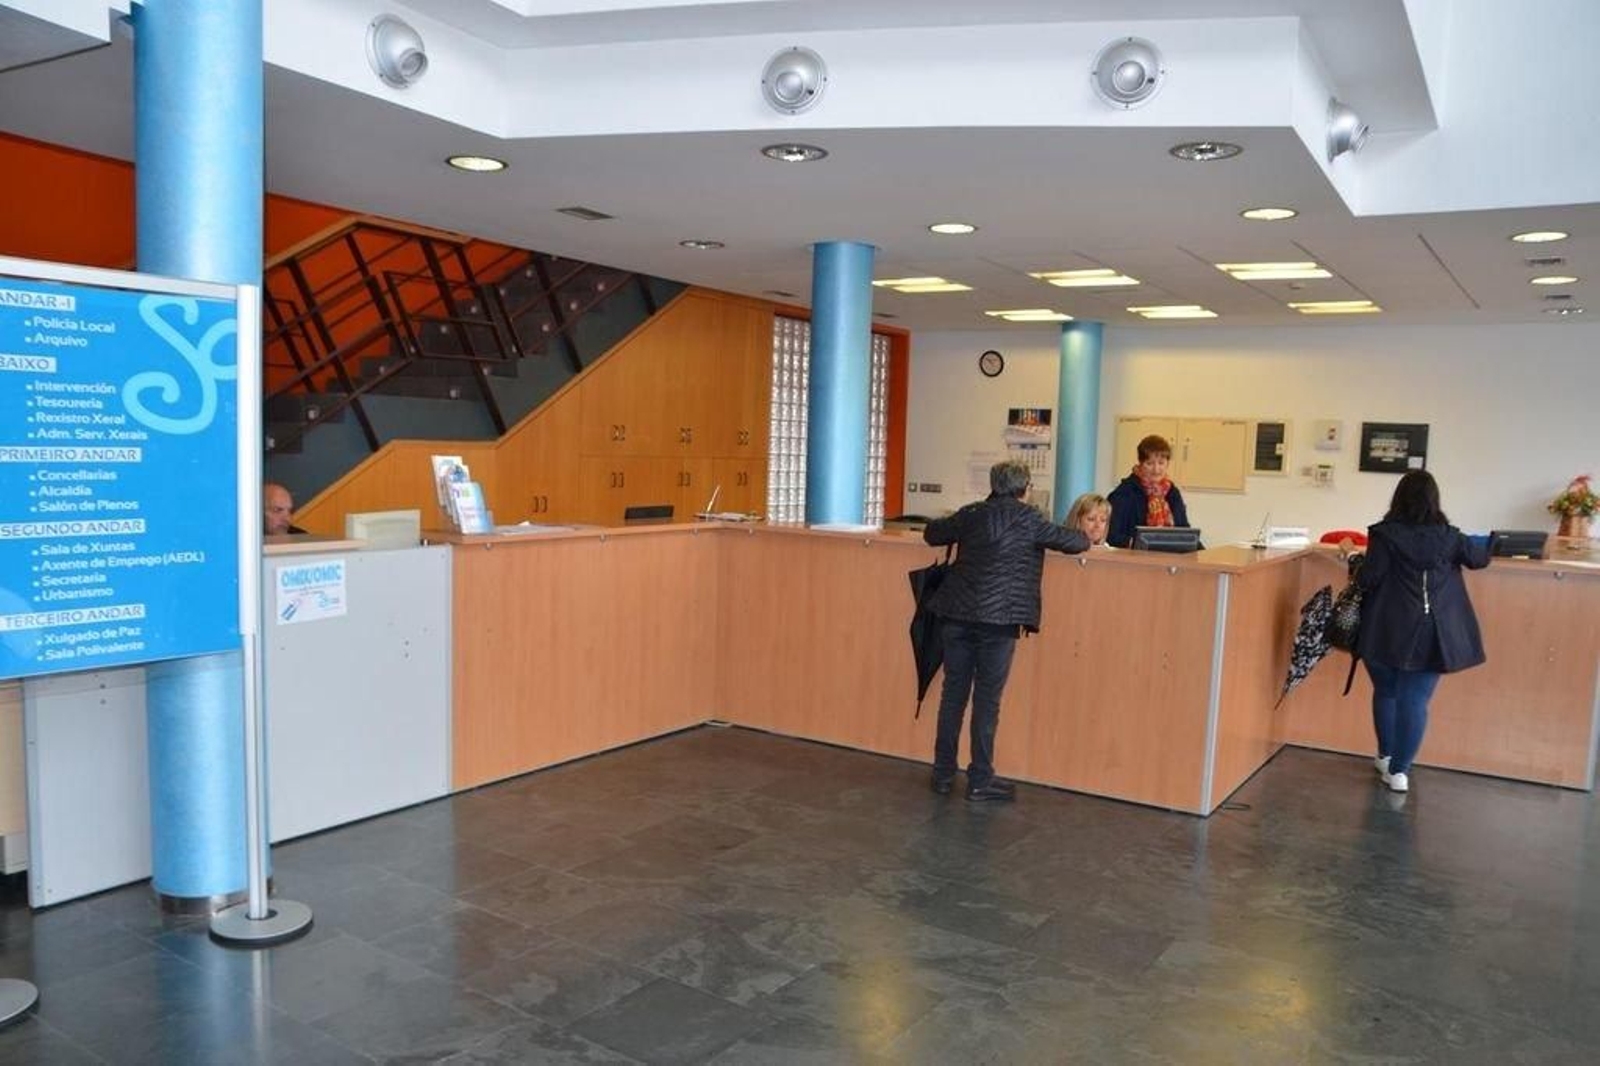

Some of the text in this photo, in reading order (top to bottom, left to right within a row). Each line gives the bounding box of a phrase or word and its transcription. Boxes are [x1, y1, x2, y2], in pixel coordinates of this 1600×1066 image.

[80, 320, 116, 333] Local
[34, 332, 88, 347] Arquivo
[35, 380, 116, 394] Intervención
[36, 412, 125, 424] Rexistro Xeral
[37, 428, 148, 440] Adm. Serv. Xerais
[0, 448, 137, 460] PRIMEIRO ANDAR
[39, 500, 139, 512] Salón de Plenos
[1, 521, 142, 536] SEGUNDO ANDAR
[40, 542, 136, 556] Sala de Xuntas
[41, 552, 205, 572] Axente de Emprego (AEDL)
[42, 587, 114, 601] Urbanismo
[6, 605, 142, 628] TERCEIRO ANDAR
[44, 625, 142, 645] Xulgado de Paz
[44, 640, 145, 660] Sala Polivalente
